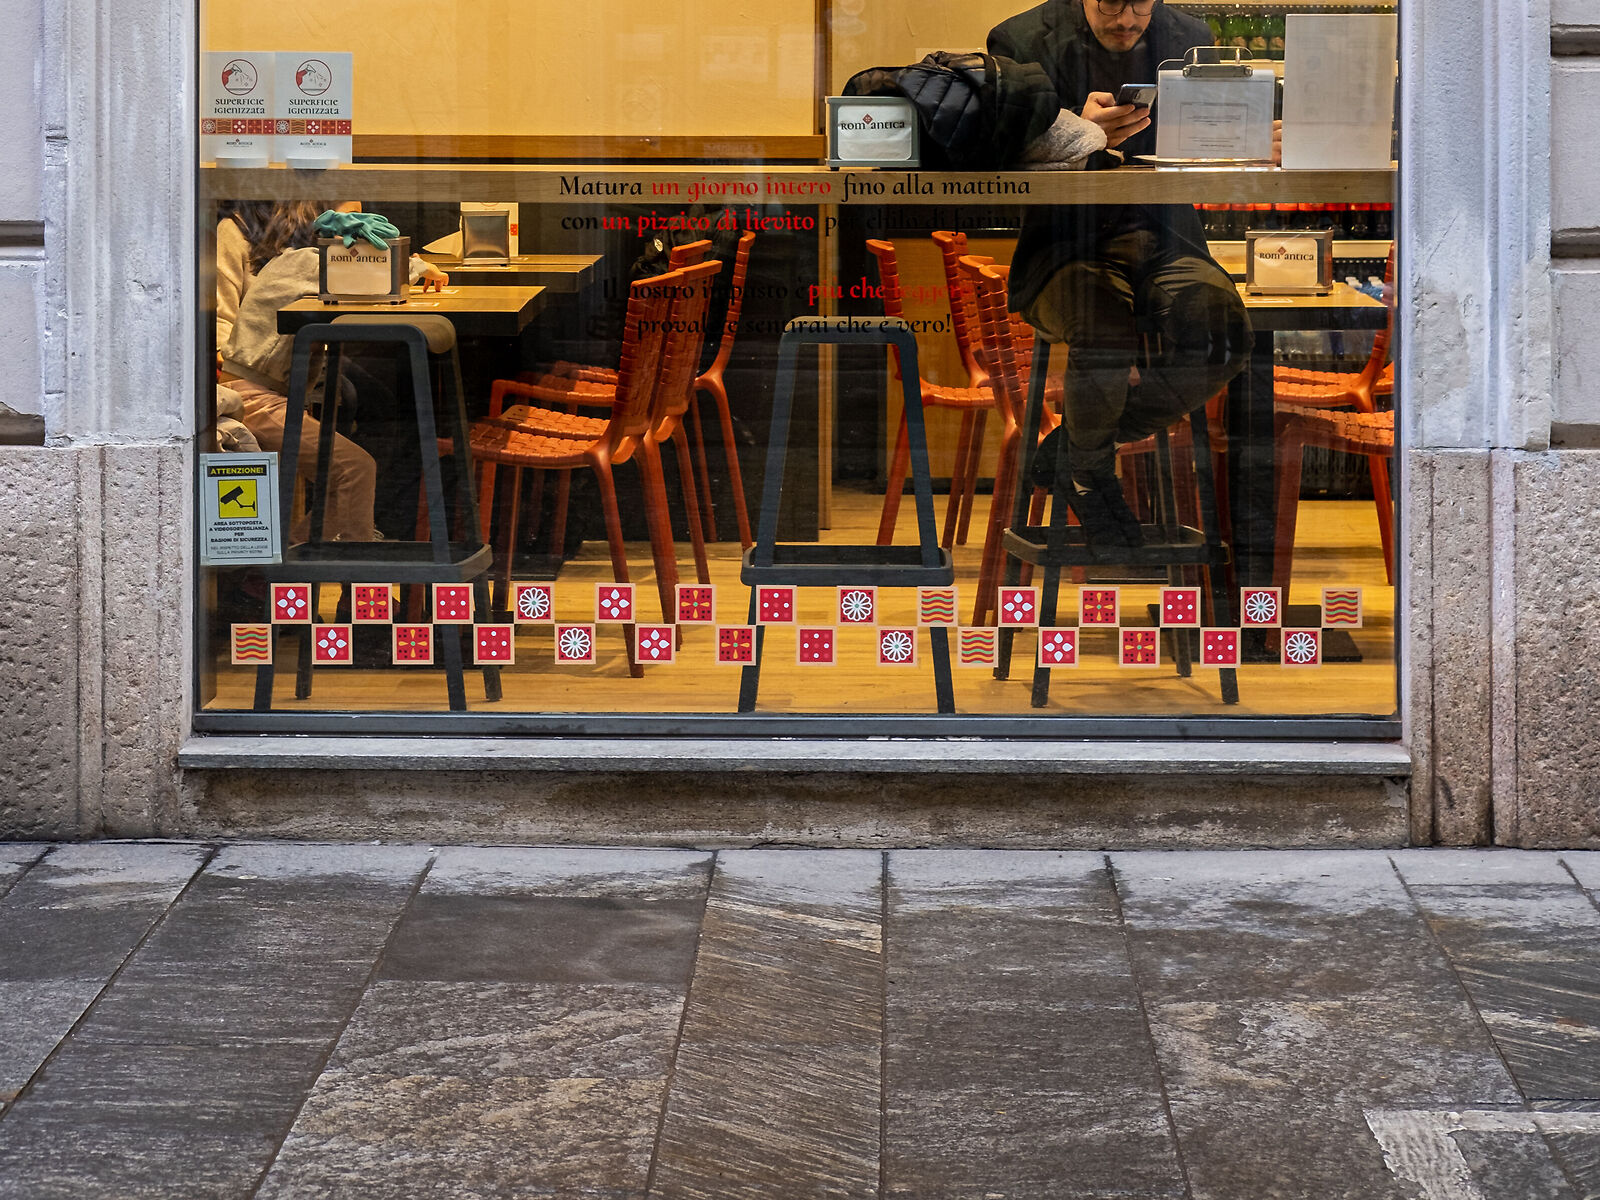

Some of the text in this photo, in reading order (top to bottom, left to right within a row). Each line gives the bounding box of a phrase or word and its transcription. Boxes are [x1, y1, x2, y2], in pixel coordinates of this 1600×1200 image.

[559, 173, 1031, 202] Matura un giorno intero fino alla mattina
[561, 215, 598, 230] con
[602, 216, 630, 230] un
[637, 210, 710, 238] pizzico
[717, 208, 737, 231] di
[745, 208, 815, 231] lievito
[628, 282, 694, 299] nostro
[808, 276, 844, 306] più
[849, 275, 885, 299] che
[638, 311, 951, 339] proval e sentirai che è vero!
[210, 467, 263, 475] ATTENZIONE!
